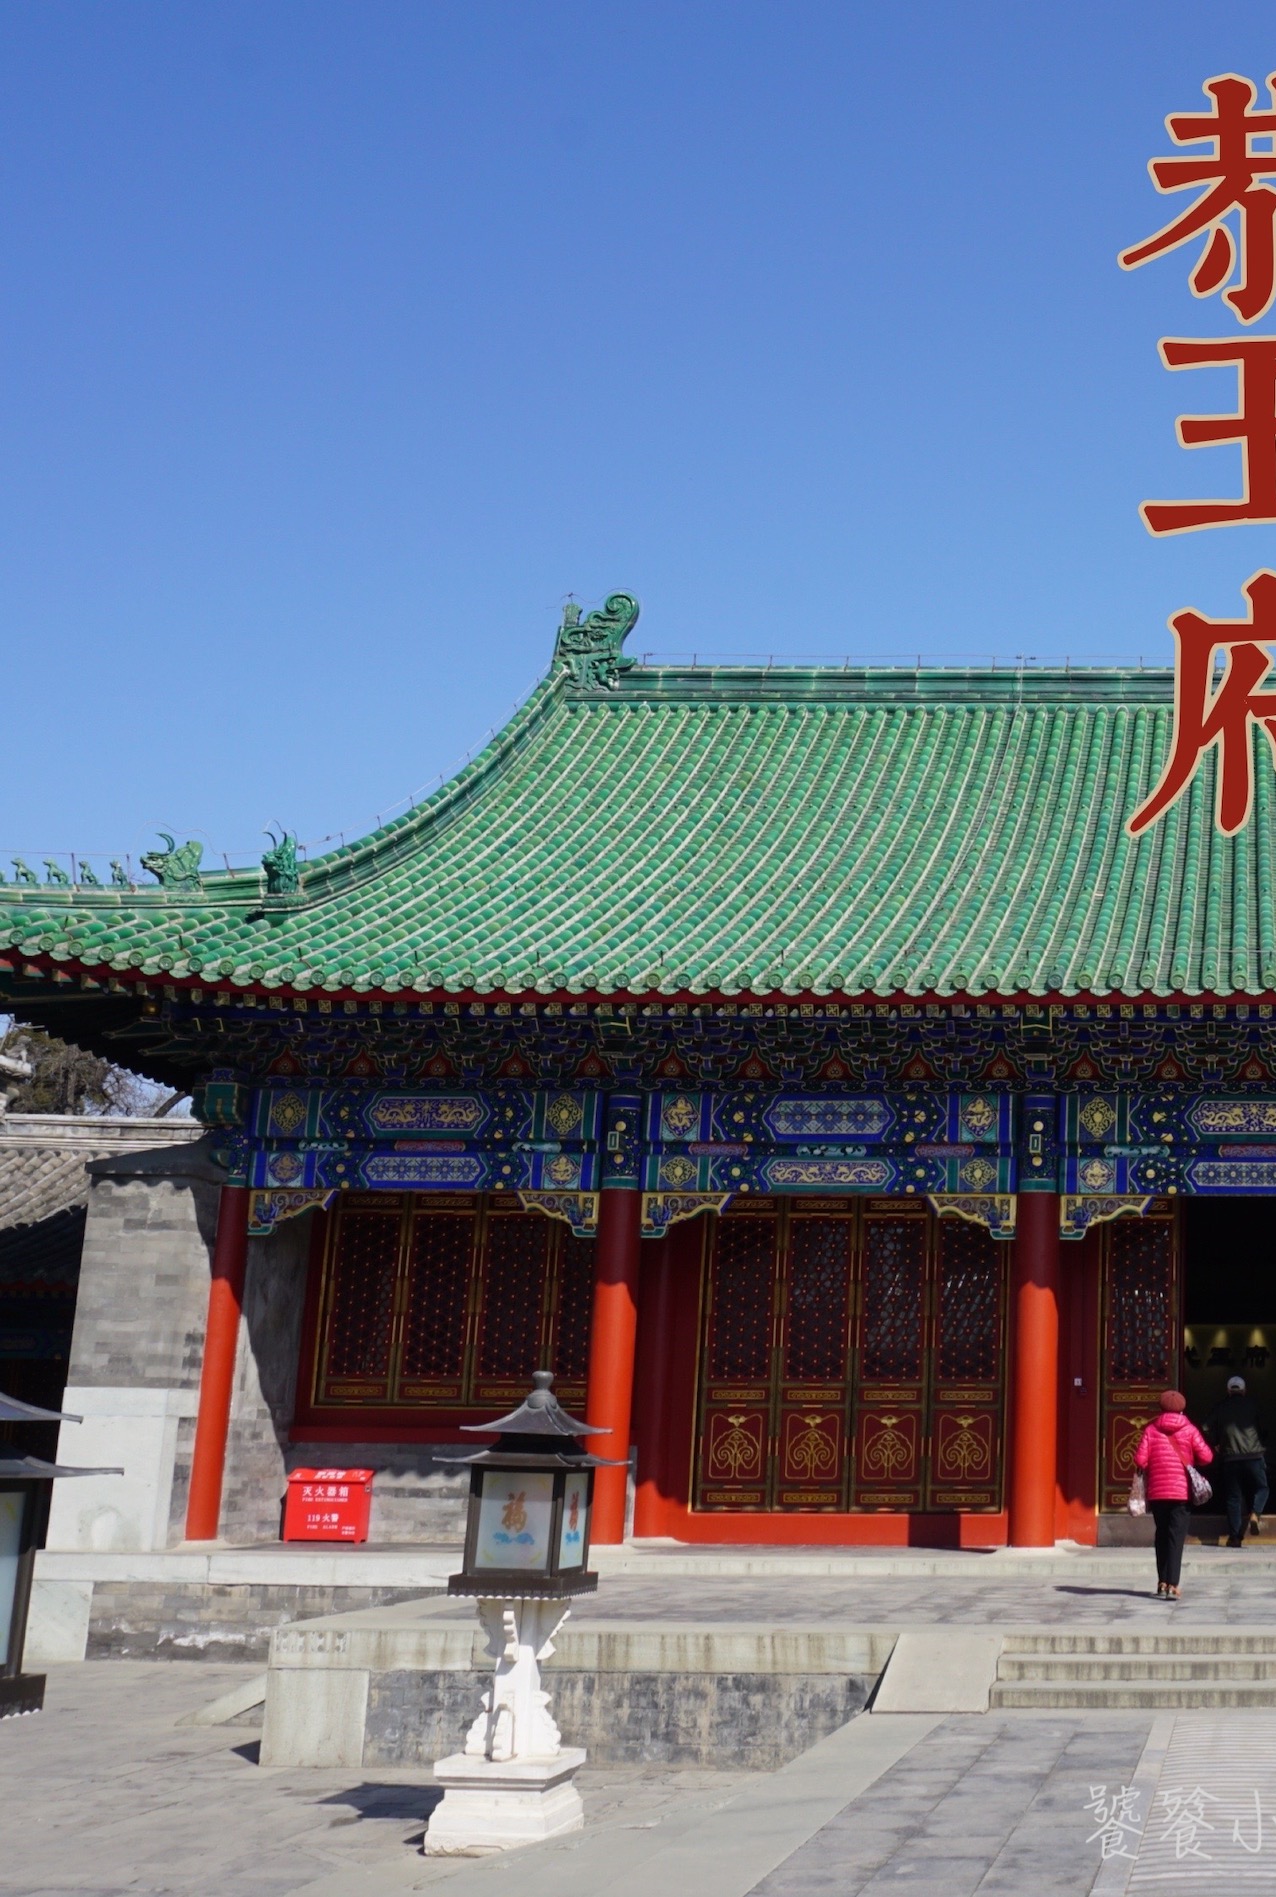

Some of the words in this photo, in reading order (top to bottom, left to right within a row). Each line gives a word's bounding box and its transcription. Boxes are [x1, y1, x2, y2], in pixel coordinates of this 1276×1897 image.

[303, 1486, 349, 1497] 灭火器箱
[307, 1514, 320, 1522] 119
[322, 1513, 339, 1522] 火警
